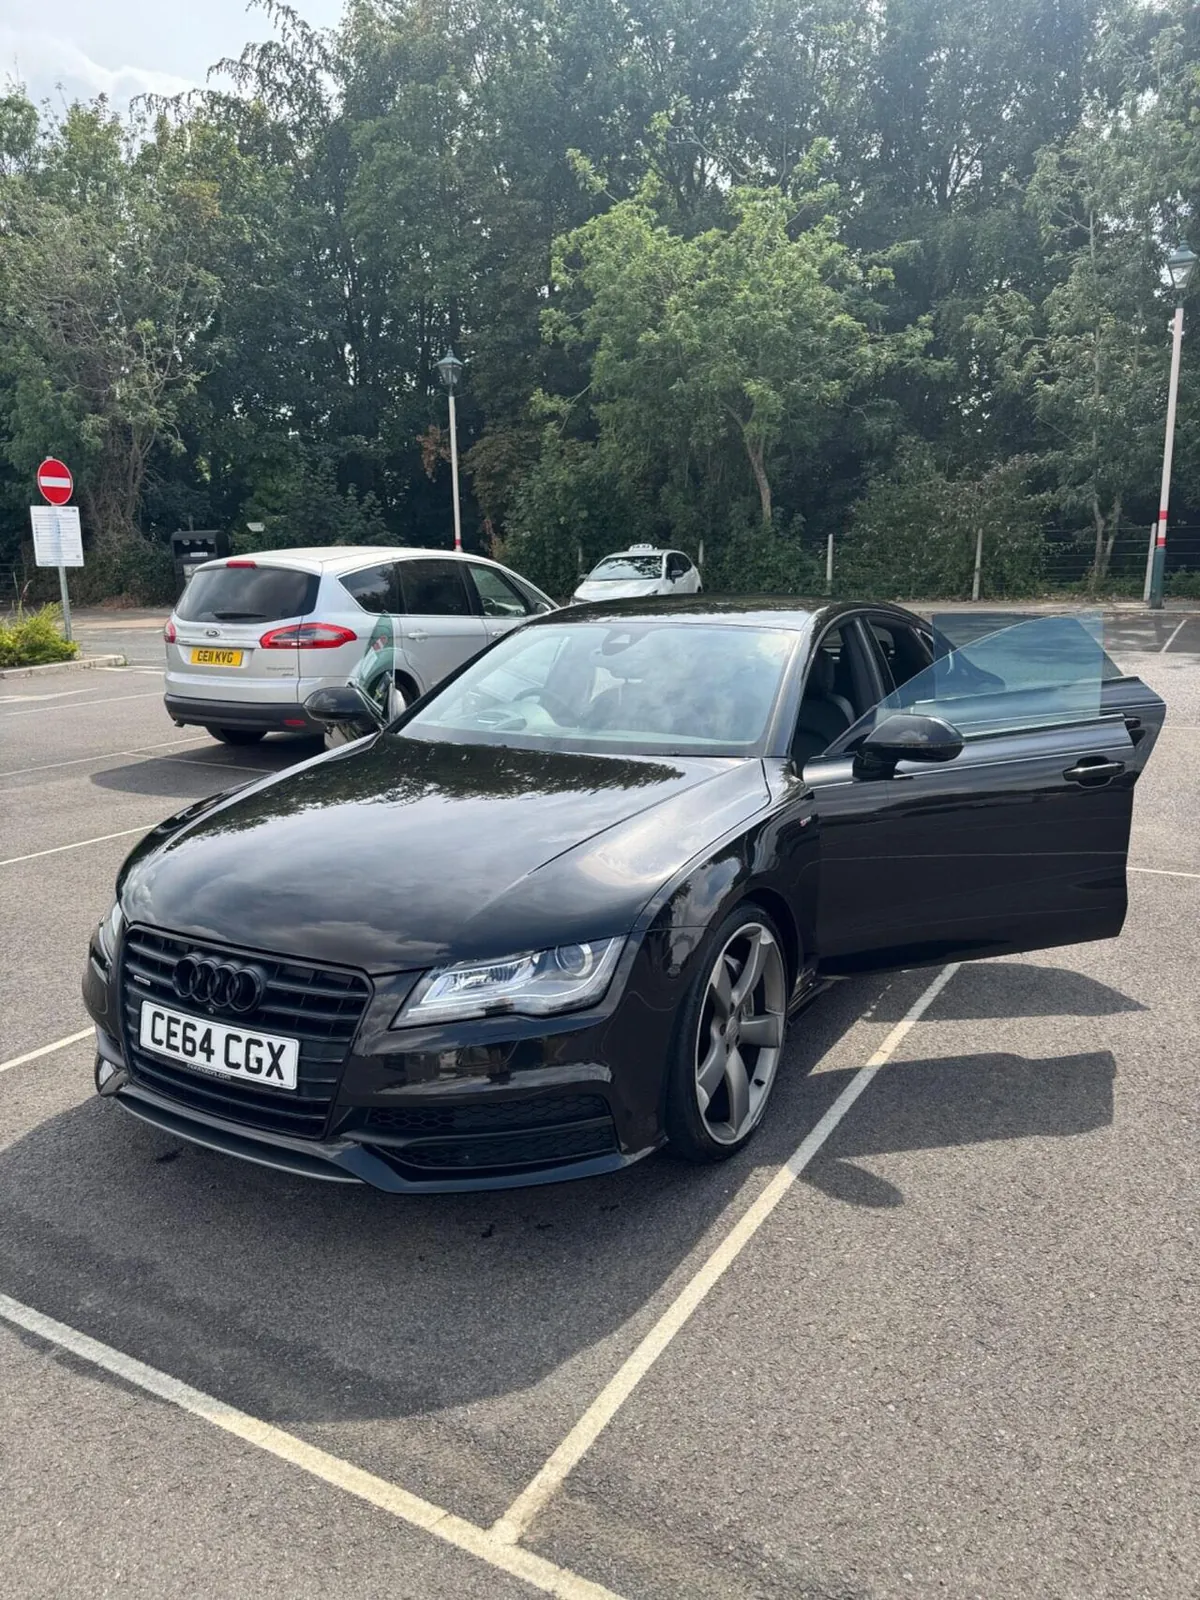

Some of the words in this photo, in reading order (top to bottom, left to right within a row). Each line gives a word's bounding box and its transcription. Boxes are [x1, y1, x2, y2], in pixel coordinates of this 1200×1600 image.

[197, 650, 214, 662] CE11
[215, 651, 234, 663] KVG
[151, 1011, 214, 1062] CE64
[224, 1033, 286, 1080] CGX
